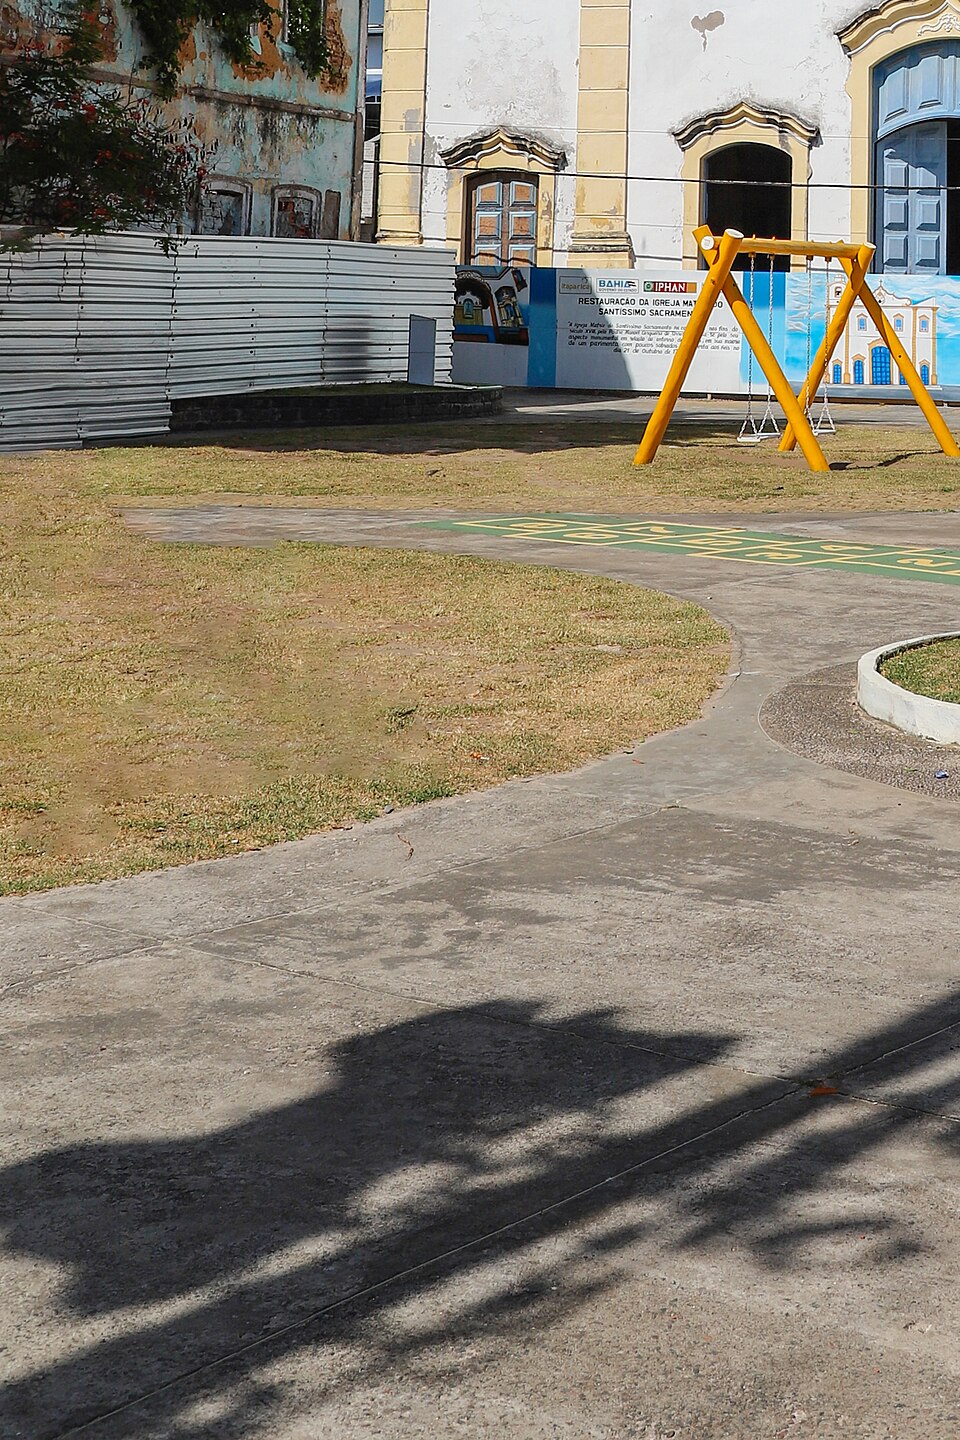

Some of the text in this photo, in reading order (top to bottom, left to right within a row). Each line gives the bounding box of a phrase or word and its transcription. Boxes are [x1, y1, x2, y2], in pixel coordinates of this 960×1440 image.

[599, 280, 633, 288] BAHIA
[655, 282, 686, 292] IPHAN
[578, 297, 636, 306] RESTAURAÇÃO
[652, 299, 680, 307] IGREJA
[598, 307, 693, 317] SANTÍSSIMO SACRAMEN
